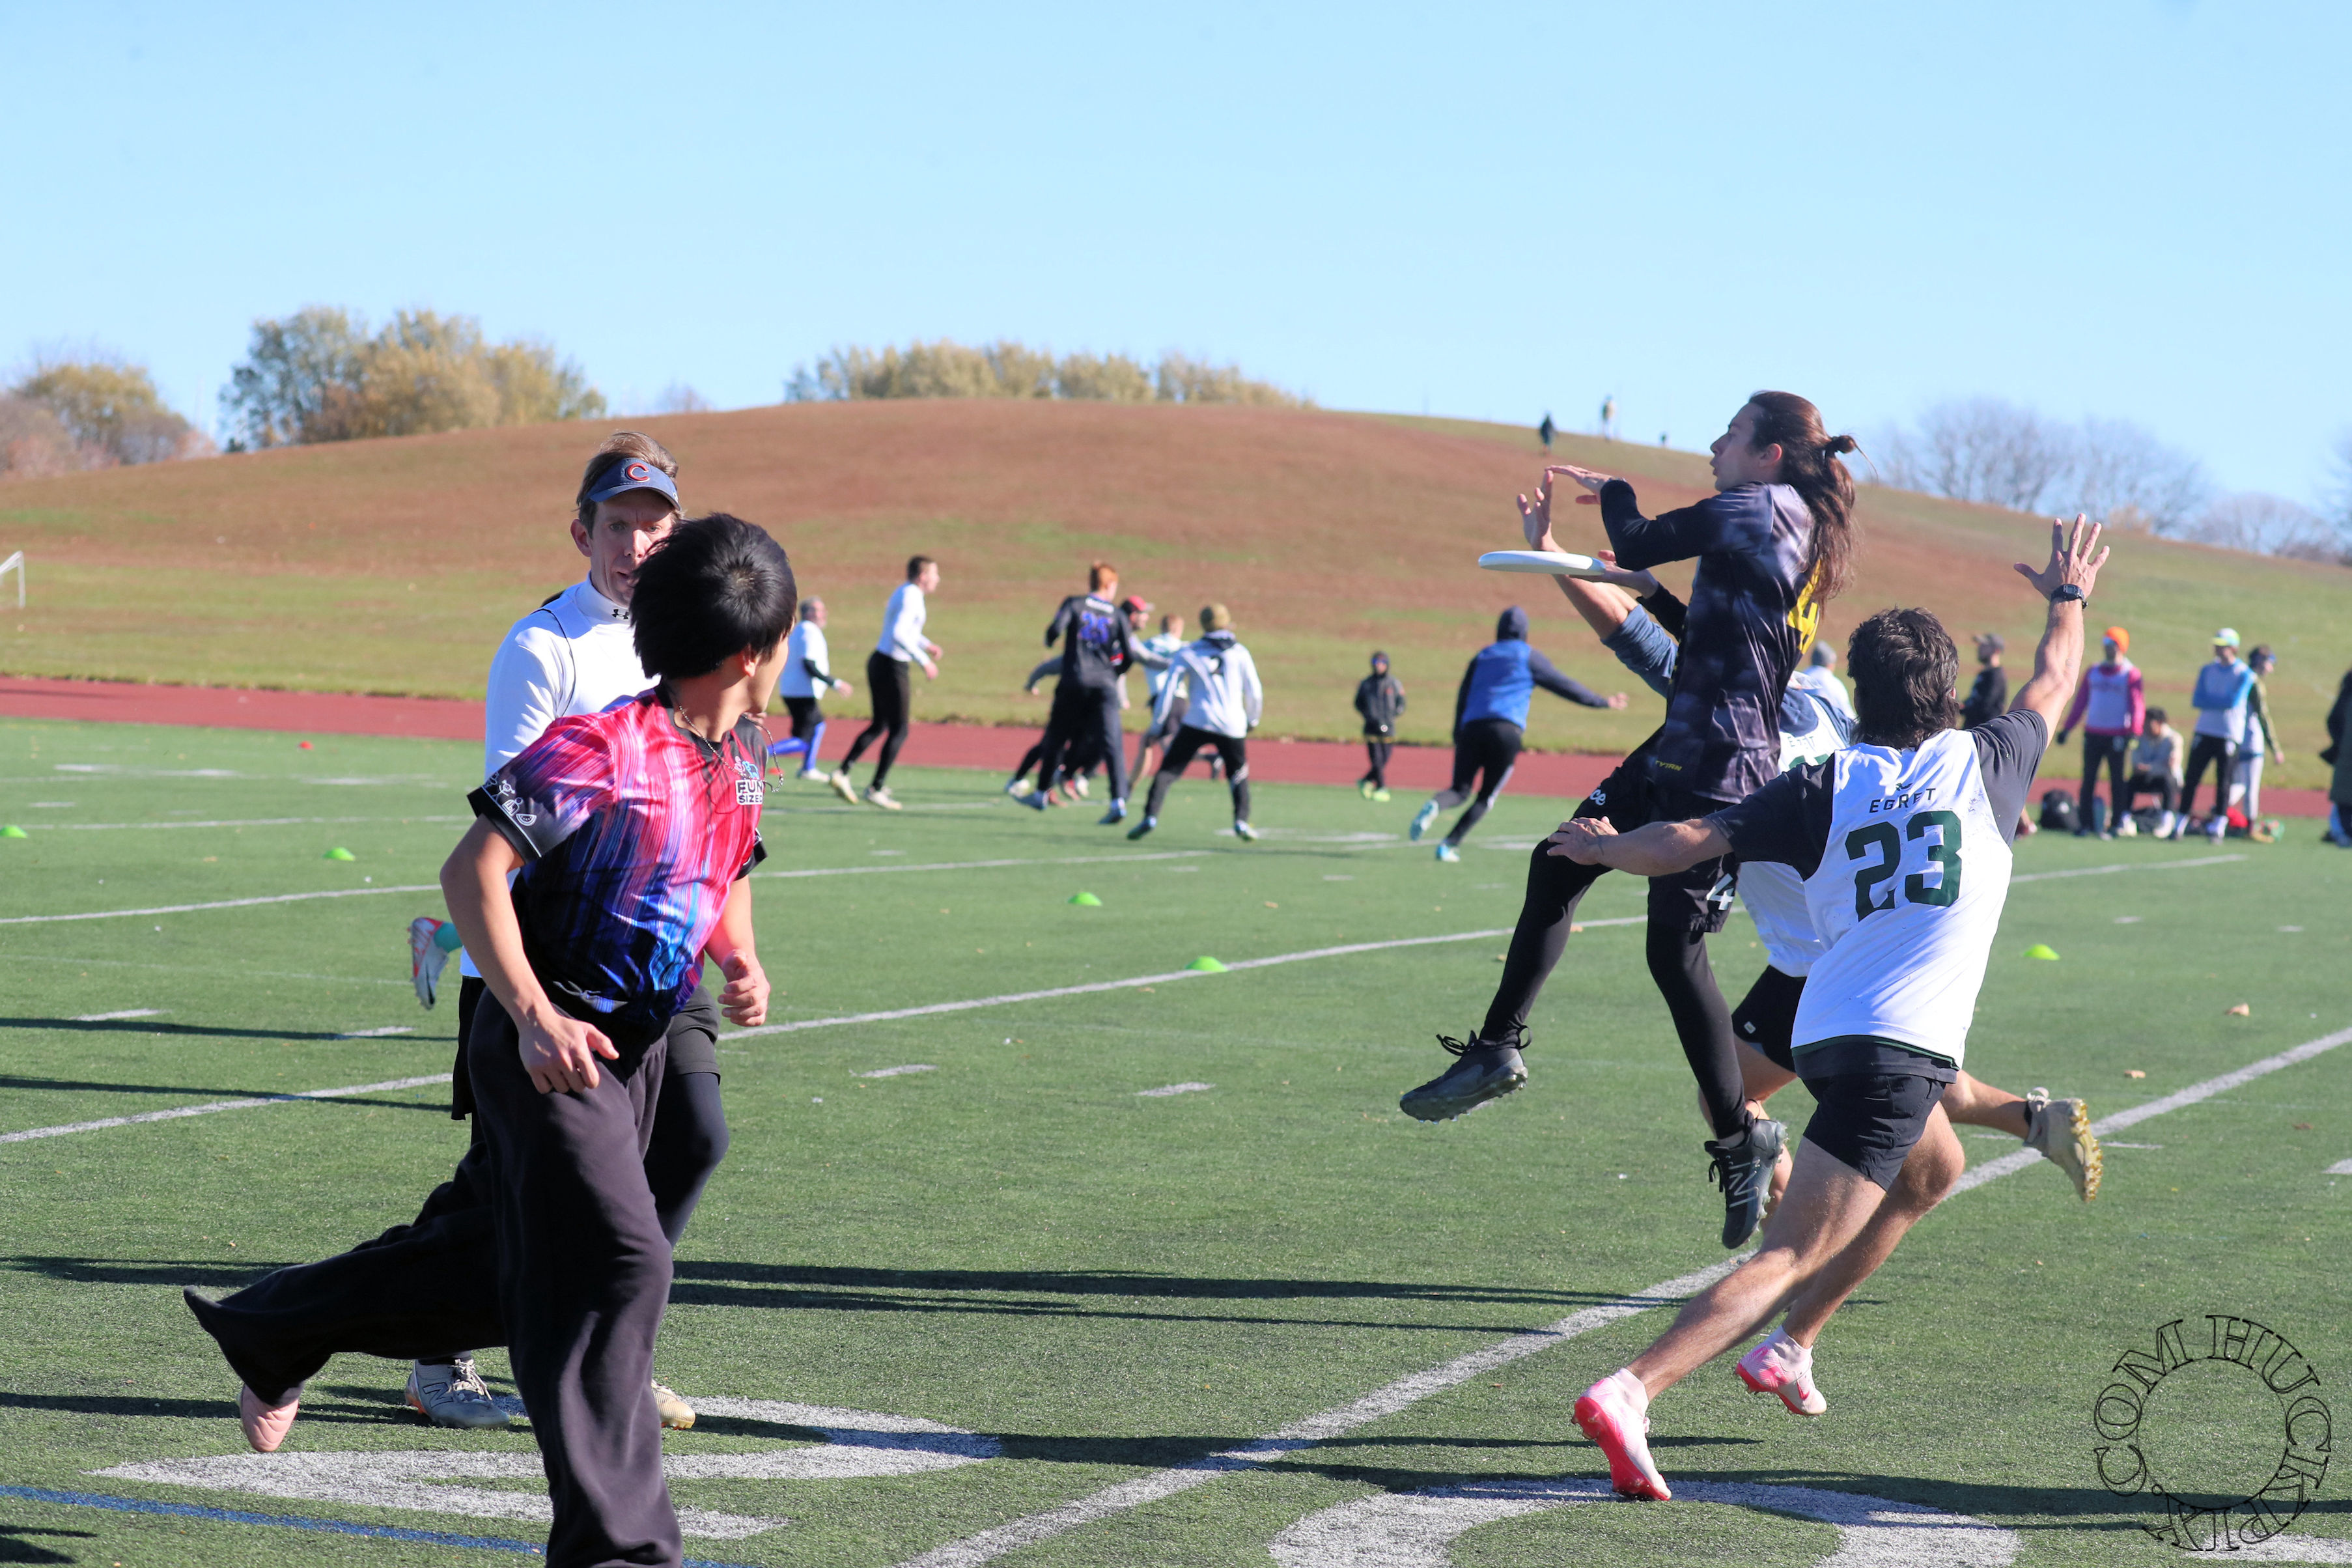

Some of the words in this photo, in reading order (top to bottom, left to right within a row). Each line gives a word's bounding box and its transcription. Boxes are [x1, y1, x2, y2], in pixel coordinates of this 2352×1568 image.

[626, 462, 650, 482] C
[737, 781, 763, 793] FUN
[1869, 788, 1936, 813] EGRET
[1845, 810, 1962, 922] 23
[1706, 873, 1733, 910] 4
